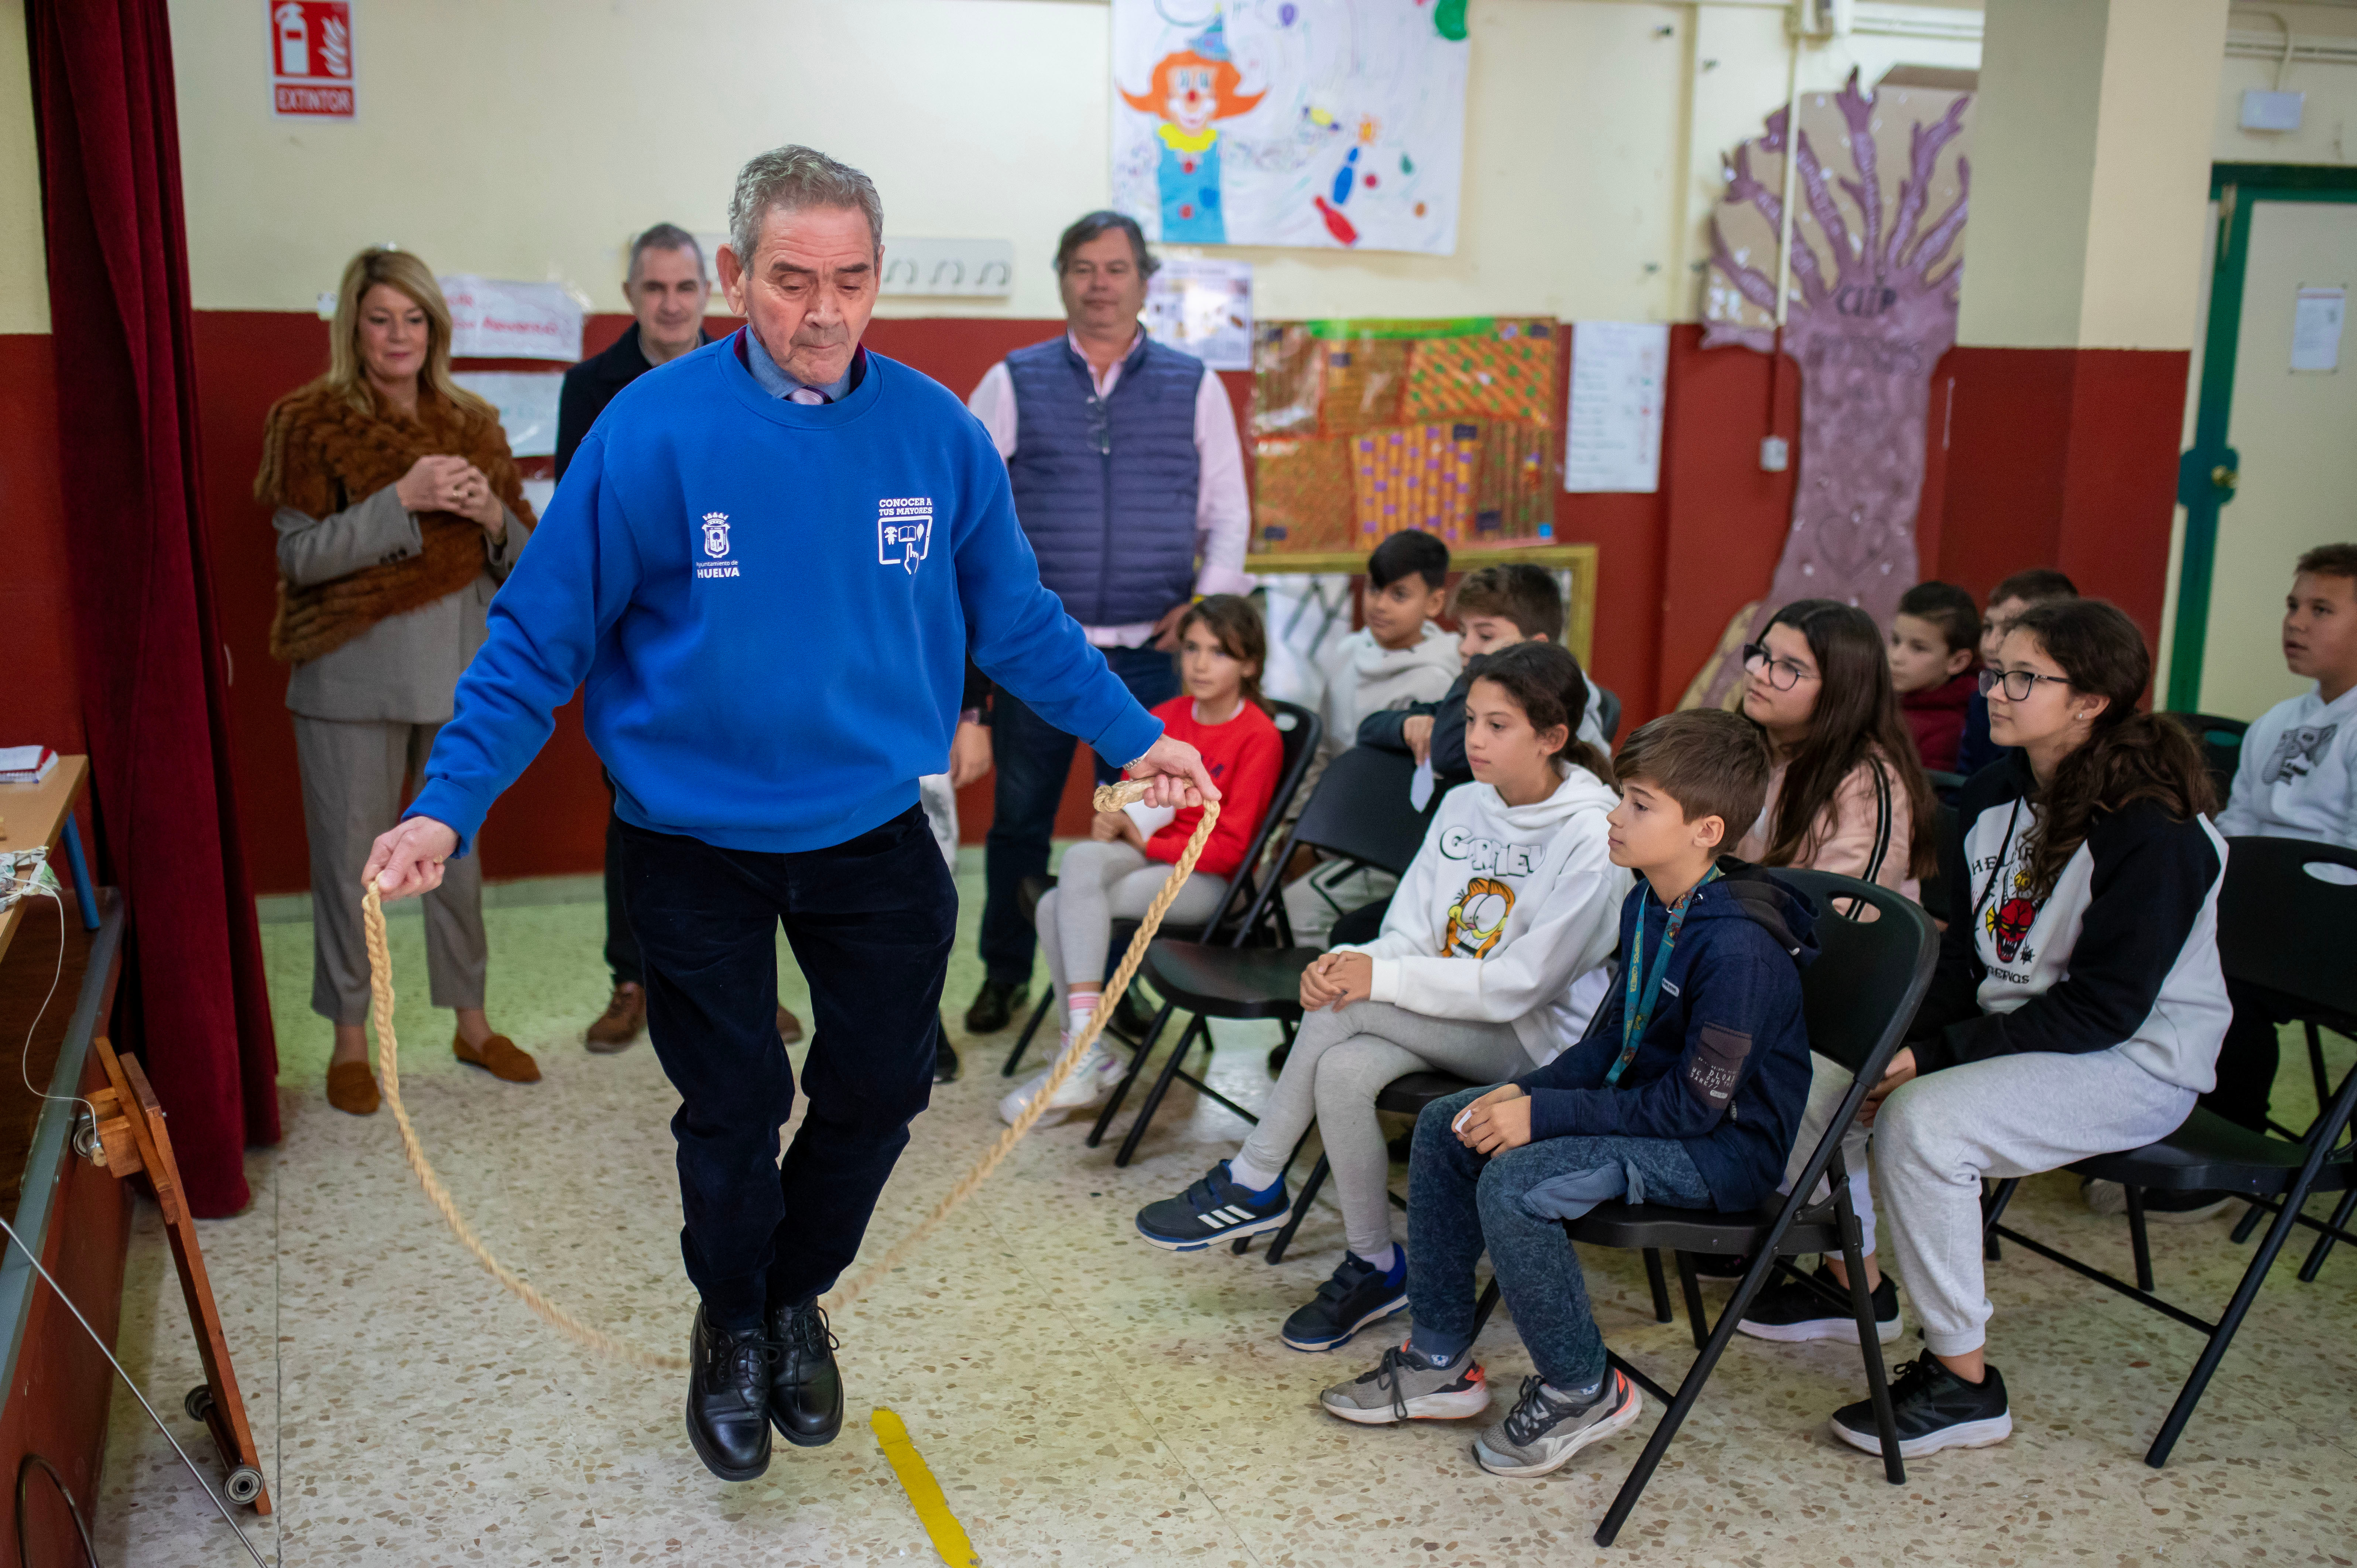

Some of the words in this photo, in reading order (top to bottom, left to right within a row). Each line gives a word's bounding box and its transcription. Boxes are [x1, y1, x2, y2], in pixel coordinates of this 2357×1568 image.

[278, 88, 350, 112] EXTINTOR
[879, 498, 925, 507] CONOCER
[896, 507, 932, 515] MAYORES
[697, 568, 740, 578] HUELVA
